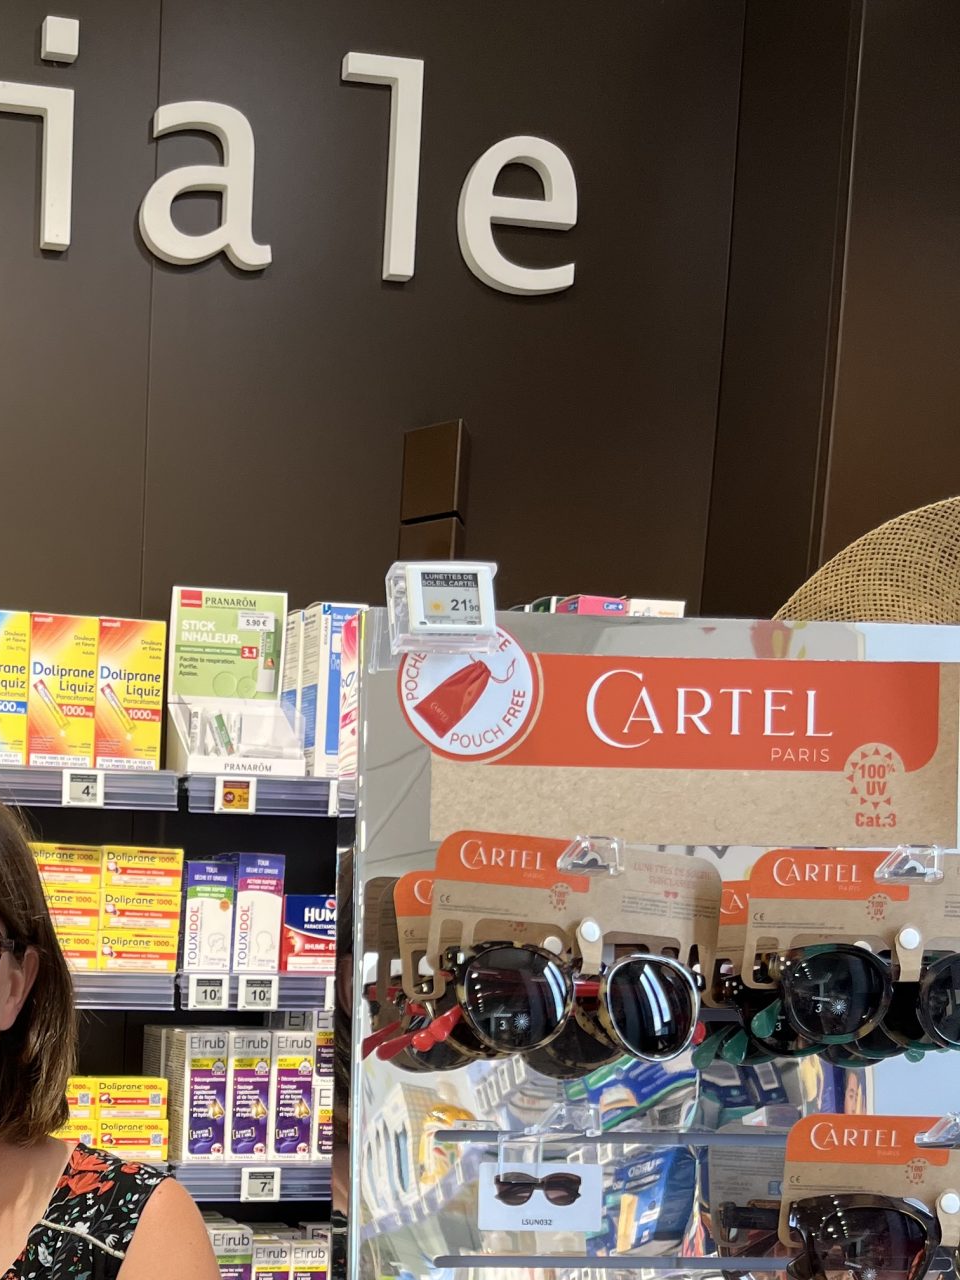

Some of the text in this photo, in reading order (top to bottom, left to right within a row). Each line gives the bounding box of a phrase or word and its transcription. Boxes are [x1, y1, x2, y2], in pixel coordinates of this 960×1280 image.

[205, 597, 257, 608] PRANARÔM
[182, 619, 216, 632] STICK
[246, 619, 260, 627] 5.90
[181, 632, 241, 645] INHALEUR.
[32, 662, 95, 679] Doliprane
[405, 652, 427, 701] POCHE
[59, 681, 95, 694] Liquiz
[586, 669, 833, 748] CARTEL
[449, 689, 526, 748] POUCH FREE
[771, 747, 831, 763] PARIS
[224, 762, 272, 772] PRANARÔM
[859, 763, 896, 779] 100%
[866, 781, 887, 796] UV
[460, 839, 545, 870] CARTEL
[773, 857, 862, 887] CARTEL
[187, 907, 200, 967] TOUXIDOL
[237, 906, 250, 967] TOUXIDOL
[190, 1036, 225, 1049] Efirub
[233, 1036, 268, 1049] Efirub
[277, 1036, 312, 1049] Efirub
[810, 1121, 902, 1151] CARTEL
[212, 1233, 250, 1249] Efirub
